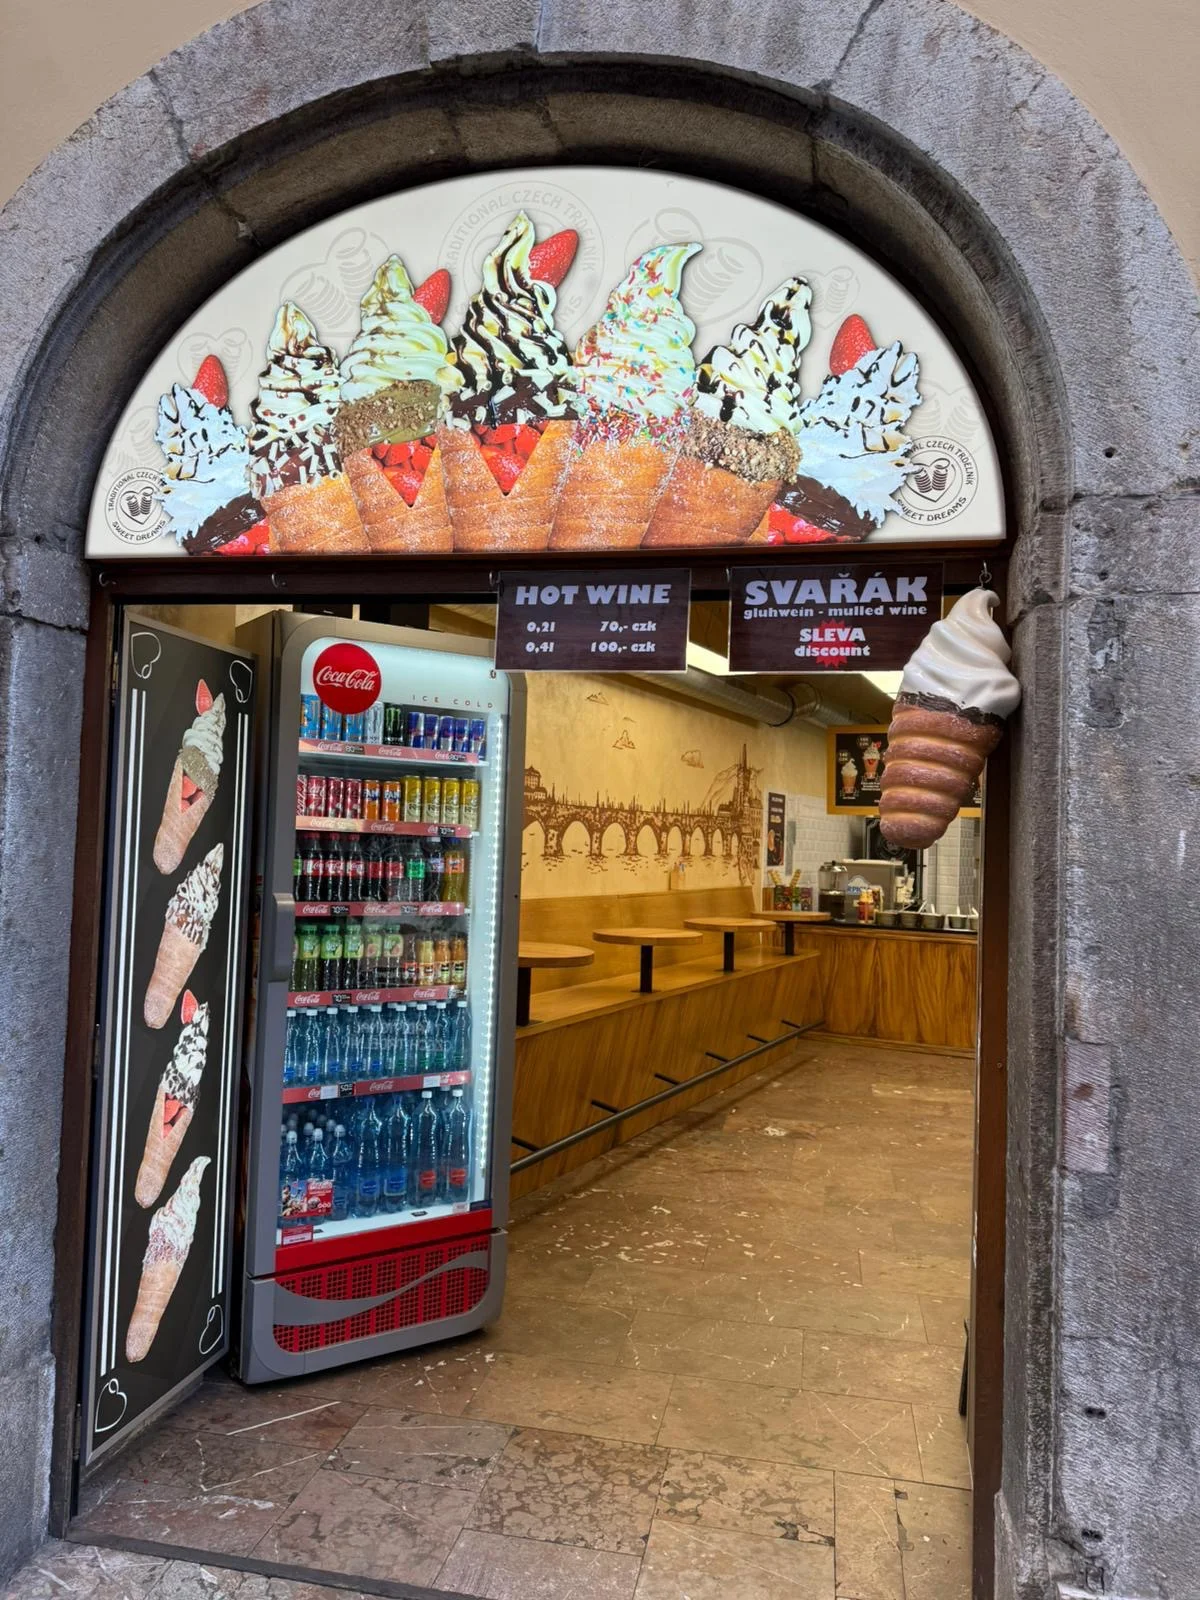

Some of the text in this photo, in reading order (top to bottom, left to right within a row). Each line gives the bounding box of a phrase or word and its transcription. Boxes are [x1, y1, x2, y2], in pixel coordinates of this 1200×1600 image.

[446, 194, 508, 276] RADITIONAL
[511, 190, 563, 209] CZECH
[926, 441, 955, 453] CZECH
[108, 474, 135, 512] TRADITIONAL
[136, 471, 158, 483] CZECH
[926, 496, 967, 522] DREAMS
[112, 520, 166, 541] SWEET DREAMS
[515, 584, 672, 605] HOT WINE
[744, 571, 928, 606] SVAŘÁK
[743, 607, 814, 620] gluhwein
[828, 605, 884, 617] mulled
[889, 604, 928, 616] wine
[600, 620, 628, 633] 70,-
[632, 620, 657, 632] czk
[799, 627, 866, 643] SLEVA
[631, 641, 656, 653] czk
[794, 644, 871, 657] discount
[316, 665, 379, 691] Coca-Cola
[412, 694, 495, 710] ICE COLD
